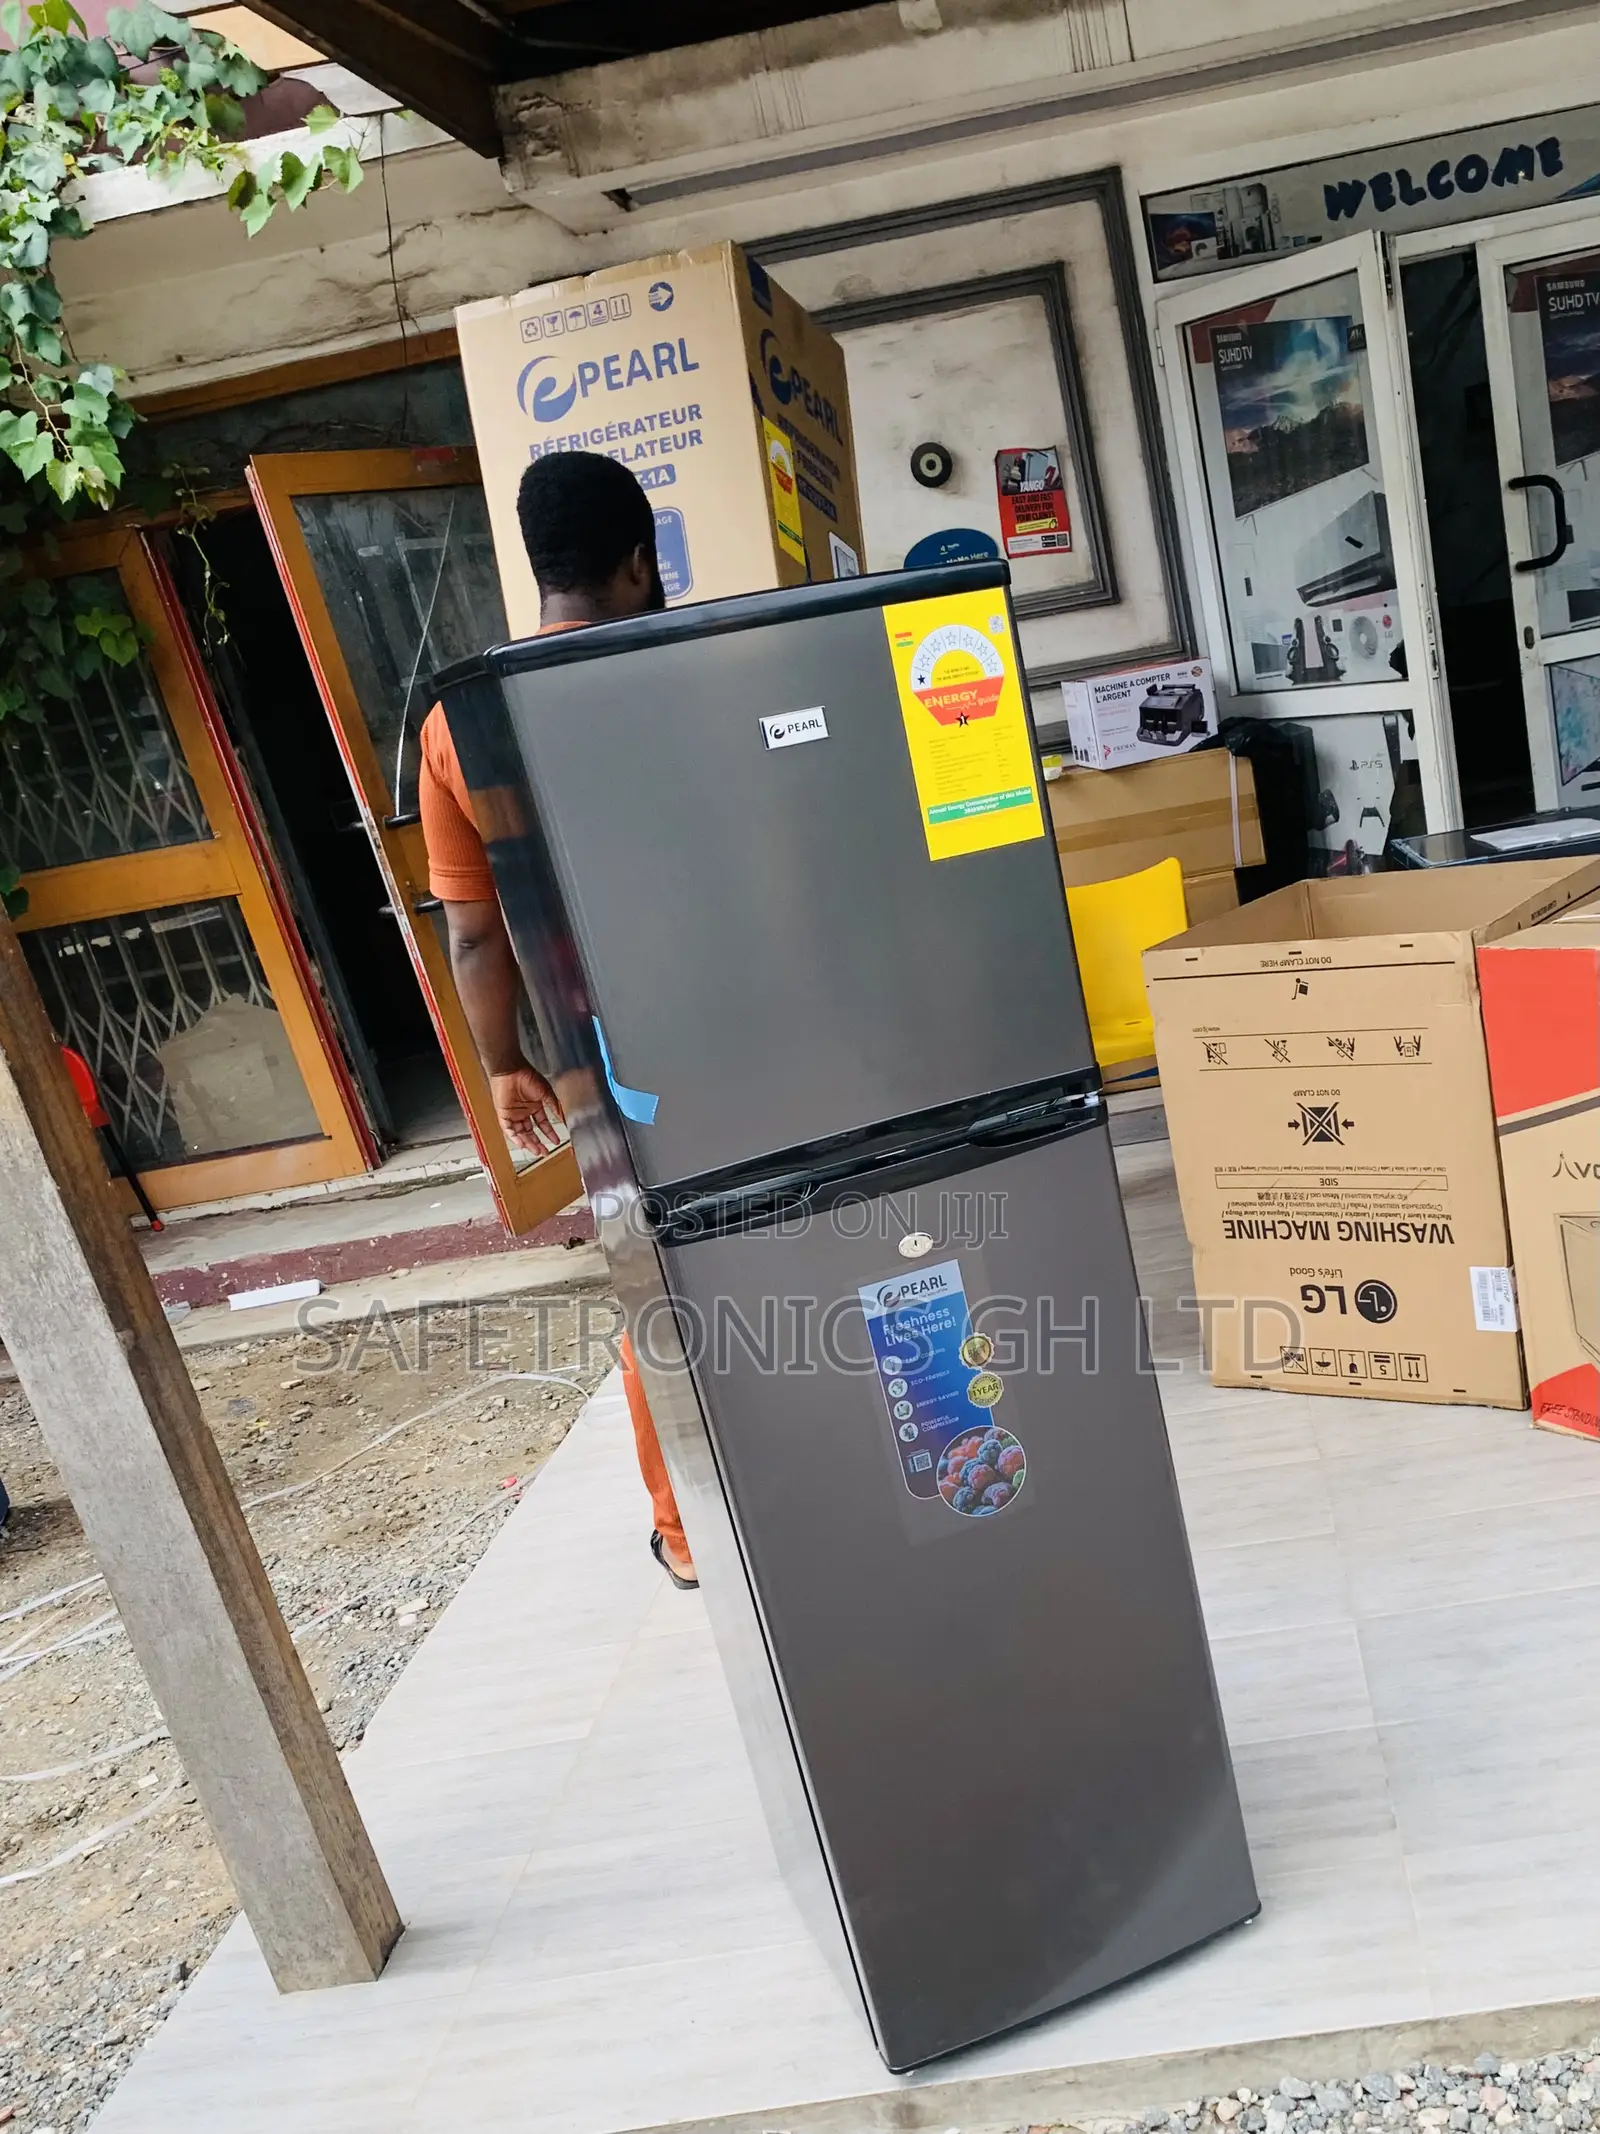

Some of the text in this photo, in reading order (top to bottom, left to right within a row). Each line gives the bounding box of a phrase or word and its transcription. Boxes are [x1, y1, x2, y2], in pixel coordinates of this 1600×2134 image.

[1323, 136, 1564, 222] WELCOME
[577, 337, 700, 399] PEARL
[791, 366, 844, 447] PEARL
[1020, 479, 1045, 493] YANGO
[1094, 681, 1128, 694] MACHINE
[1129, 680, 1135, 688] A
[1135, 672, 1171, 687] COMPTER
[924, 689, 978, 709] ENERGY
[1096, 690, 1132, 704] L'ARGENT
[787, 718, 823, 734] PEARL
[1260, 956, 1332, 968] DO NOT CLAMP HERE
[1293, 1088, 1341, 1097] DO NOT CLAMP
[1320, 1177, 1339, 1187] SIDE
[1222, 1219, 1455, 1244] WASHING MACHINE
[1289, 1267, 1343, 1278] Life's Good
[900, 1274, 948, 1298] PEARL
[1299, 1284, 1348, 1315] LG
[883, 1307, 951, 1336] Freshness
[885, 1315, 957, 1347] Lives Here!
[976, 1383, 999, 1396] YEAR
